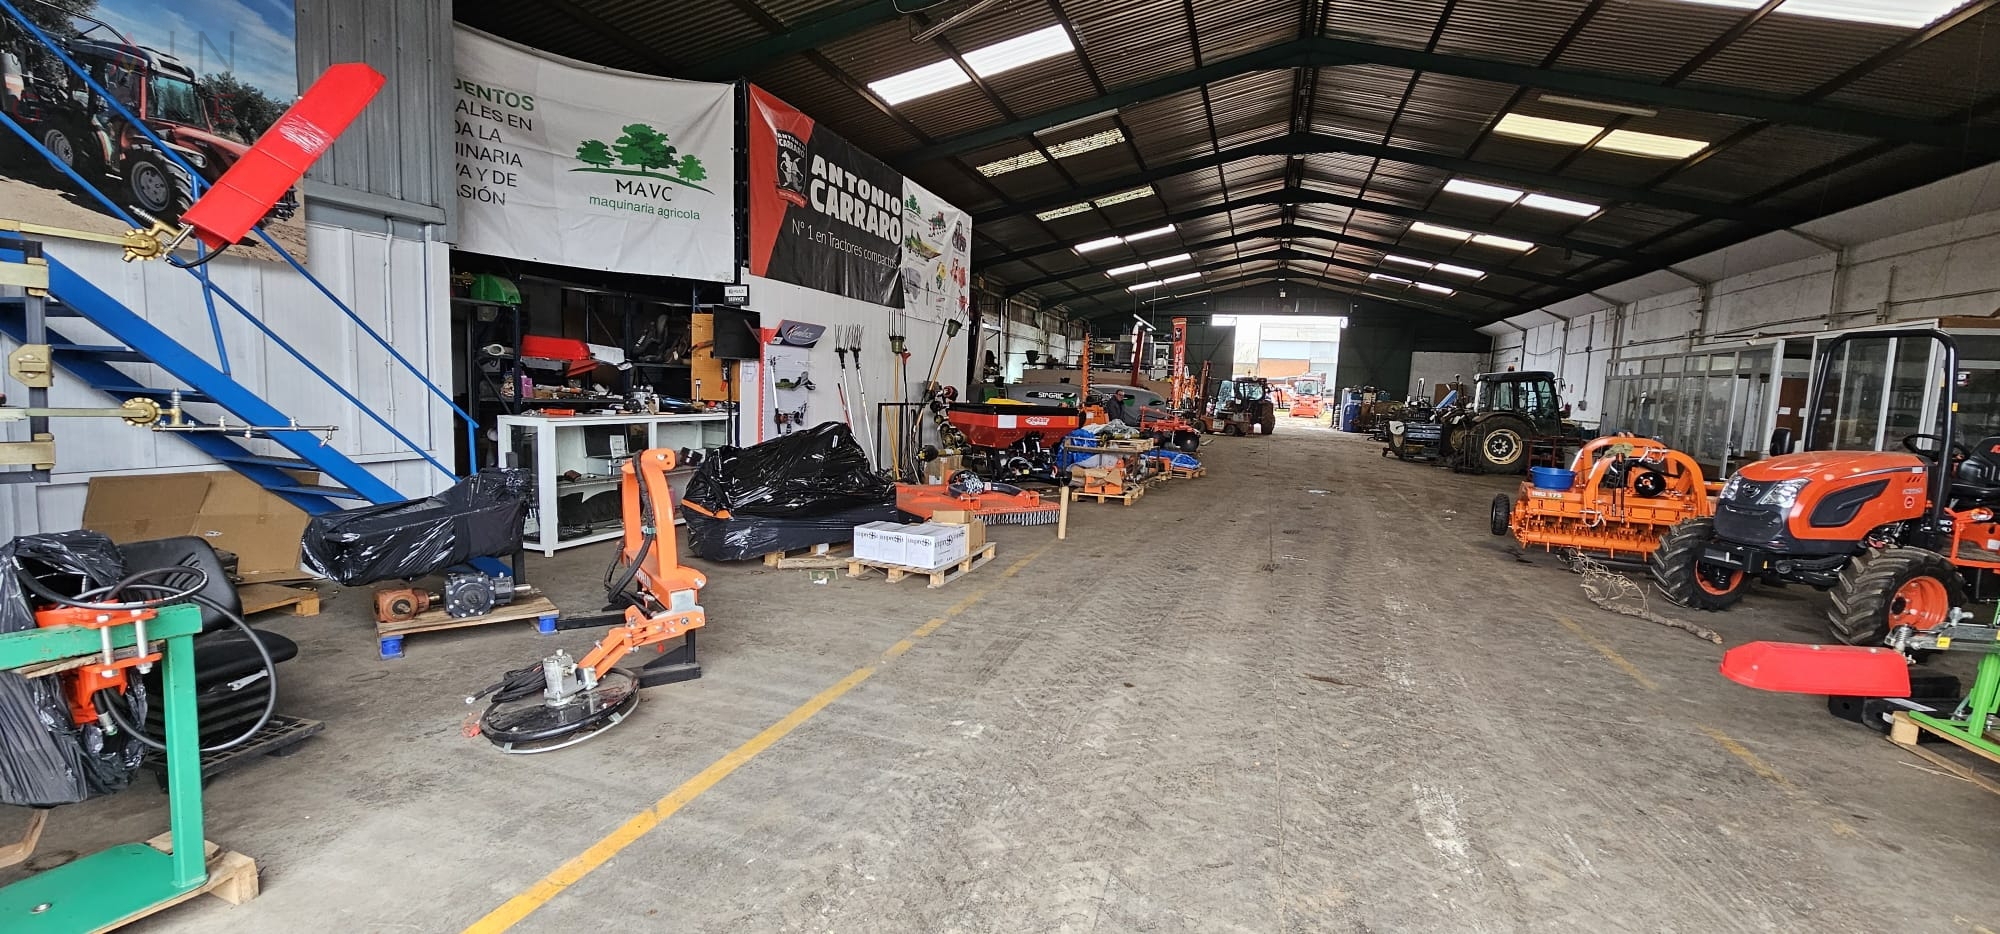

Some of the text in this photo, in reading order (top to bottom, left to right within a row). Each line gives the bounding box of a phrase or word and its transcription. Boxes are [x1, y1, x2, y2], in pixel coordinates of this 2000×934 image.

[479, 125, 502, 143] LA
[507, 114, 532, 131] EN
[455, 142, 523, 168] INARIA
[476, 167, 488, 182] Y
[492, 170, 517, 188] DE
[811, 154, 902, 216] ANTONIO
[456, 184, 506, 205] SIÓN
[615, 179, 673, 202] MAVC
[589, 196, 701, 220] maquinaria agricola
[810, 178, 902, 245] CARRARO
[807, 224, 814, 240] 1
[816, 231, 827, 245] en
[827, 231, 863, 257] Tractores
[863, 248, 897, 270] compactos
